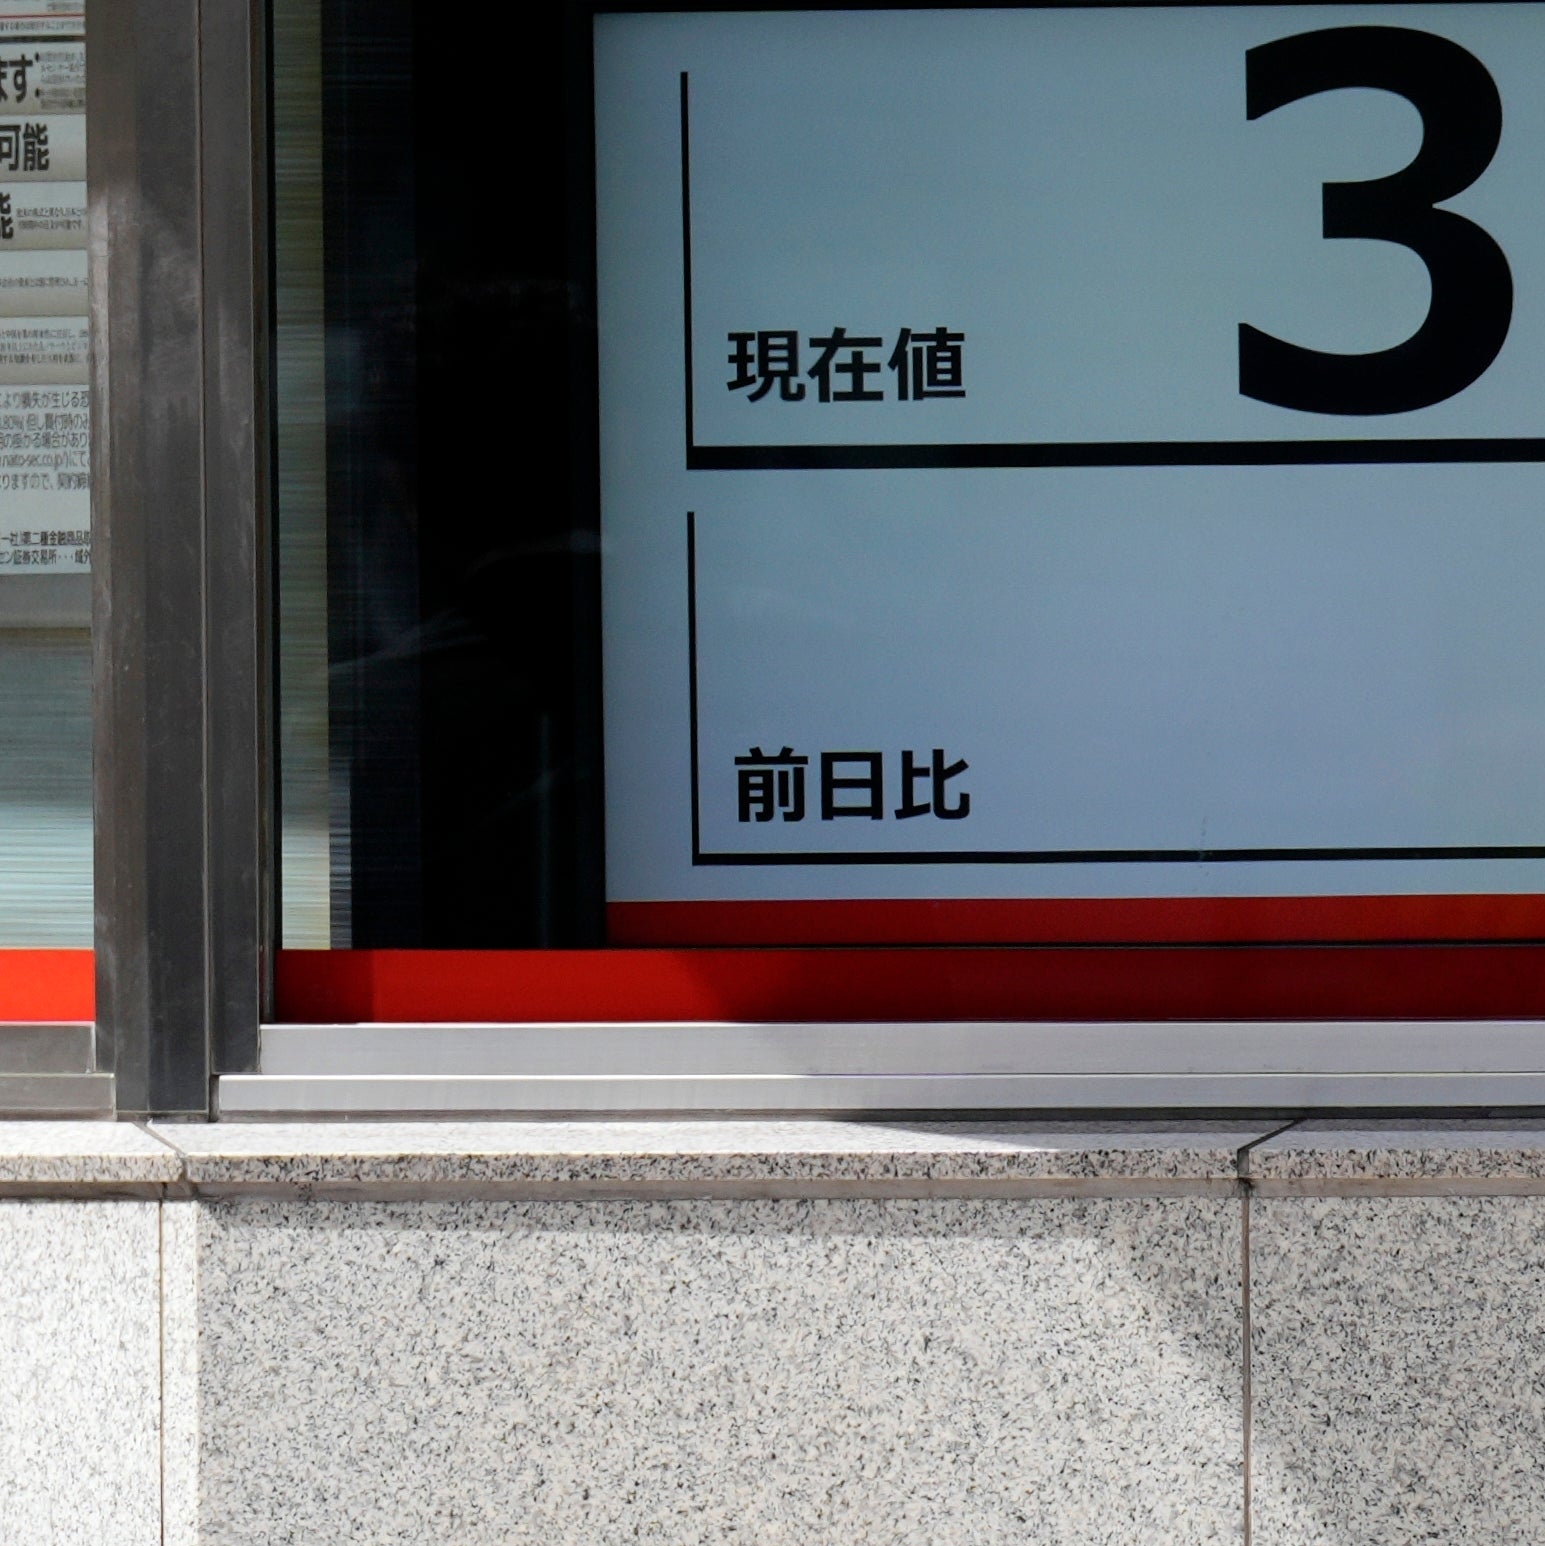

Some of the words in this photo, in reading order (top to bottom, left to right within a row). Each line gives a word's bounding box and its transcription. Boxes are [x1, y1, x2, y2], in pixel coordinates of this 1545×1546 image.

[727, 328, 967, 405] 現在値
[733, 746, 972, 824] 前日比
